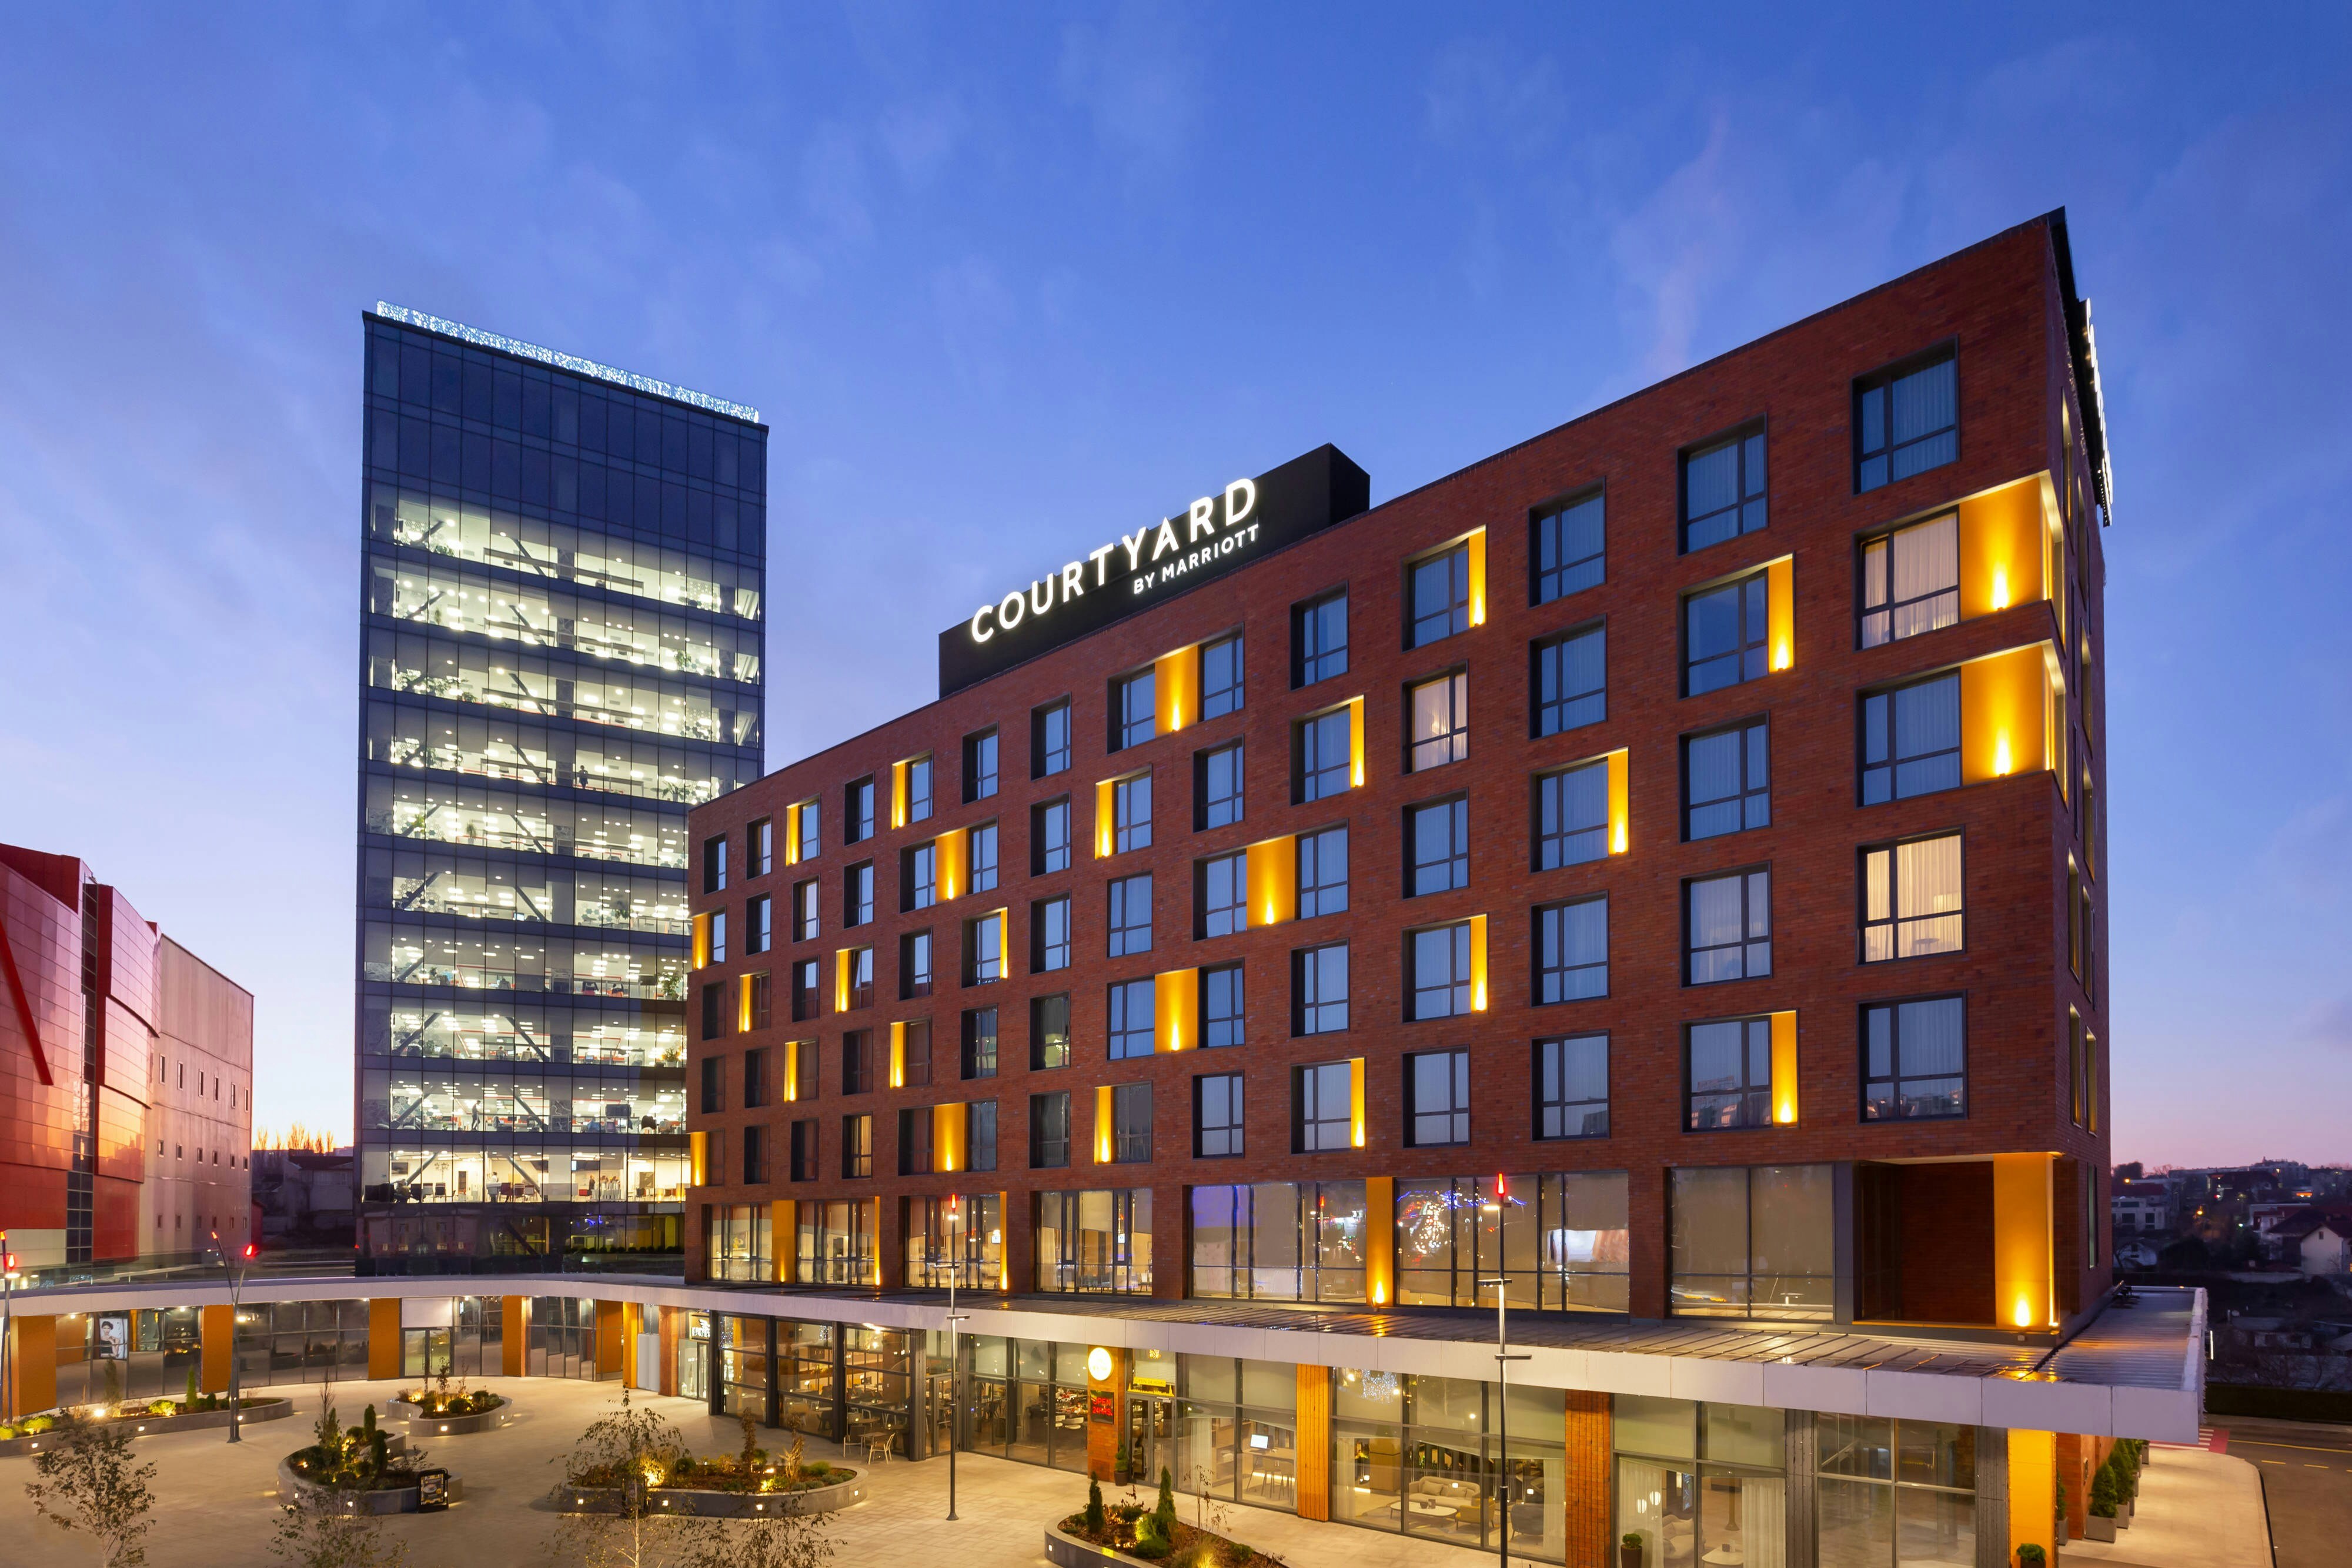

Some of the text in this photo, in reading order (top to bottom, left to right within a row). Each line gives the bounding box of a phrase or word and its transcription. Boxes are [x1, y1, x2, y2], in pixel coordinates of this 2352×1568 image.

[971, 479, 1255, 643] COURTYARD
[1134, 523, 1258, 594] BY MARRIOTT
[1092, 1397, 1111, 1406] OPEN
